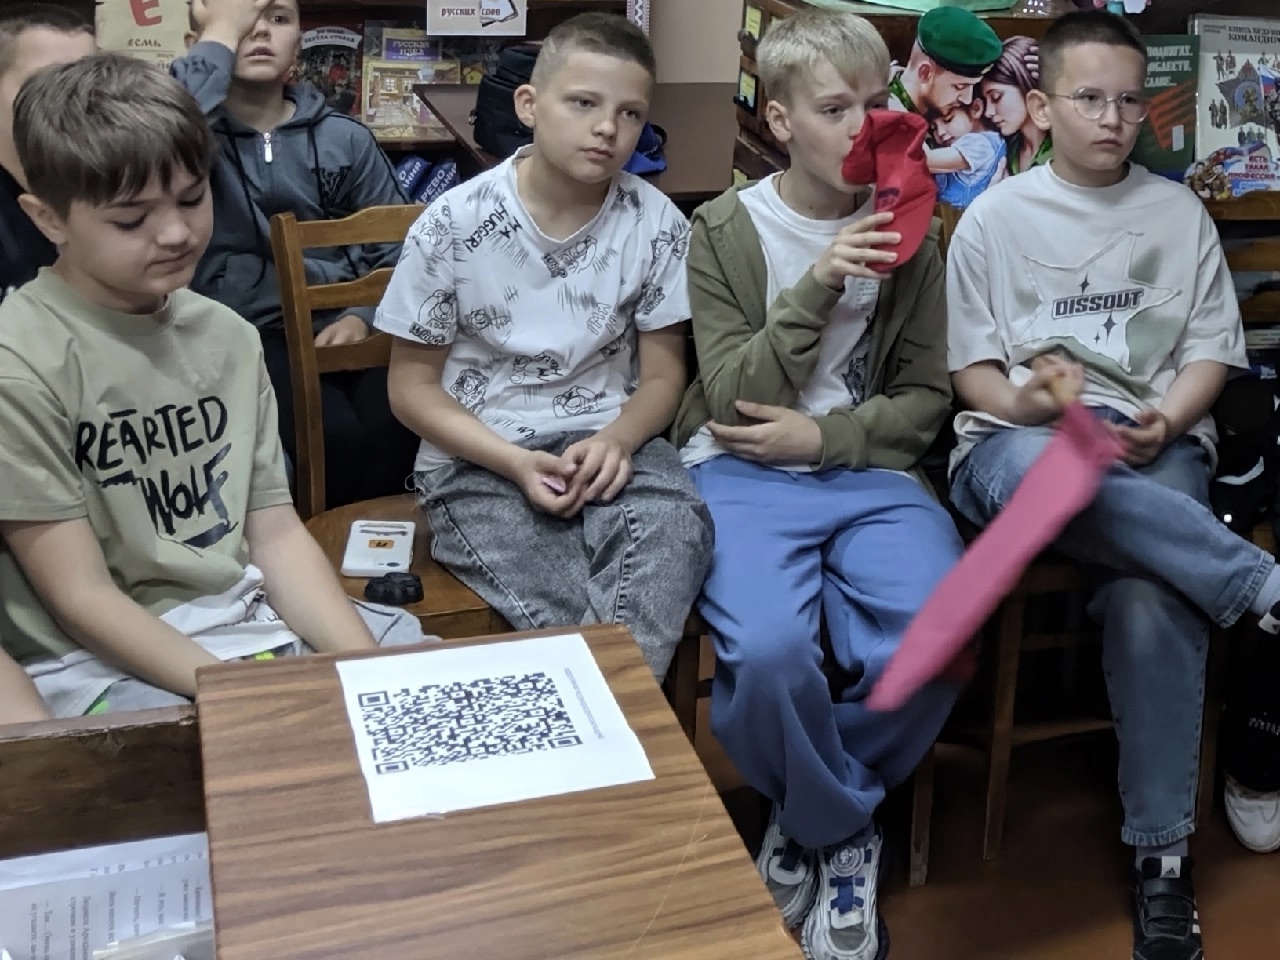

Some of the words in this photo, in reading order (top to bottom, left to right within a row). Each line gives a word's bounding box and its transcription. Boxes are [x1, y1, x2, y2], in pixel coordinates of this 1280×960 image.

[441, 8, 475, 17] русских
[481, 8, 501, 16] слов
[1054, 289, 1144, 319] DISSOUT
